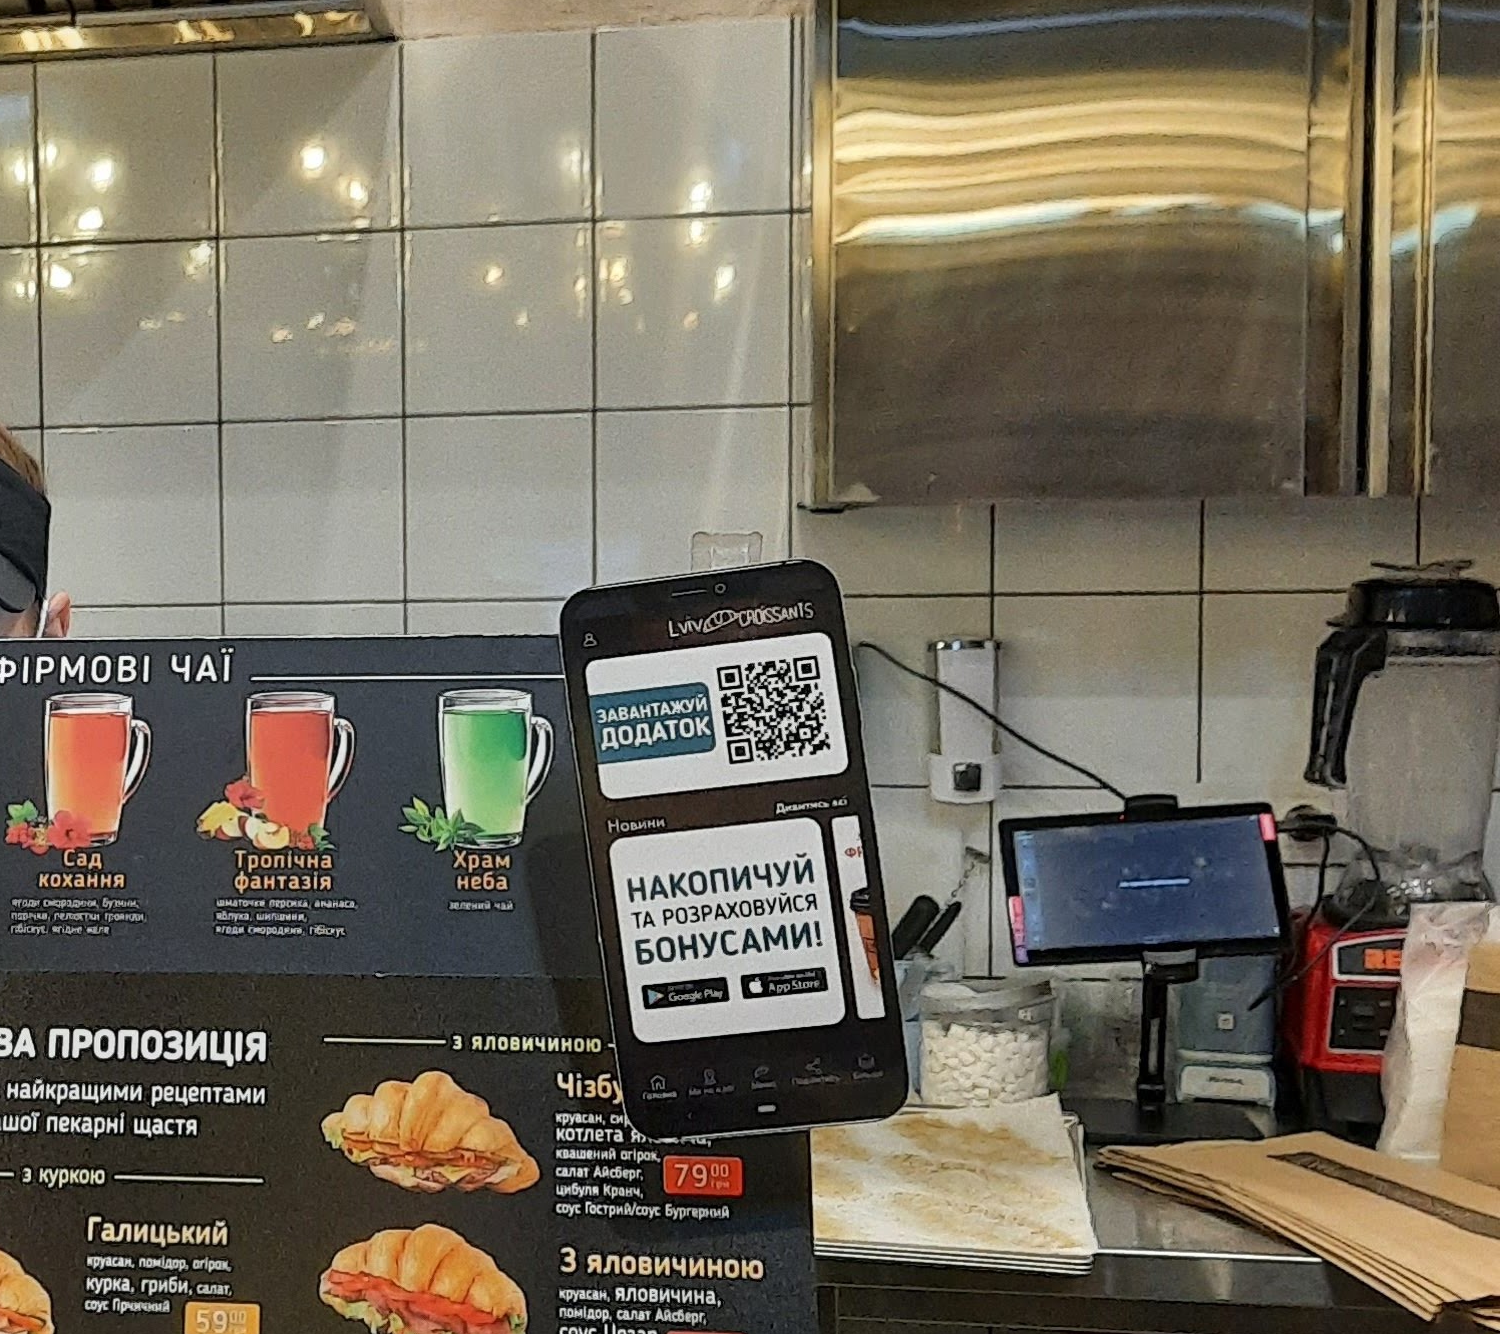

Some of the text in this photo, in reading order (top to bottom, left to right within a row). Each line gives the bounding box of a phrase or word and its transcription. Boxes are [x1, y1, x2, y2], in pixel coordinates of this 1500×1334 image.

[171, 647, 234, 683] ЧАЇ
[595, 693, 710, 726] ЗАВАНТАЖУЙ
[600, 716, 712, 751] ДОДАТОК
[607, 819, 665, 833] Новини
[60, 848, 104, 874] Сад
[234, 850, 333, 873] Тропічна
[453, 849, 510, 873] Храм
[38, 873, 125, 888] кохання
[234, 870, 332, 894] фантазія
[457, 871, 508, 891] неба
[626, 852, 817, 906] НАКОПИЧУЙ
[630, 892, 819, 930] ТА РОЗРАХОВУЙСЯ
[634, 919, 824, 966] БОНУСАМИ!
[668, 990, 702, 1003] Google
[768, 979, 820, 994] App Store
[48, 1028, 267, 1067] ПРОПОЗИЦІЯ
[471, 1035, 602, 1053] яловичиною
[6, 1078, 143, 1104] найкращими
[151, 1085, 266, 1107] рецептами
[46, 1112, 125, 1139] пекарні
[133, 1117, 198, 1138] щастя
[39, 1167, 106, 1187] куркою
[87, 1216, 228, 1248] Галицький
[587, 1254, 764, 1280] яловичиною
[86, 1275, 193, 1296] курка, гриби,
